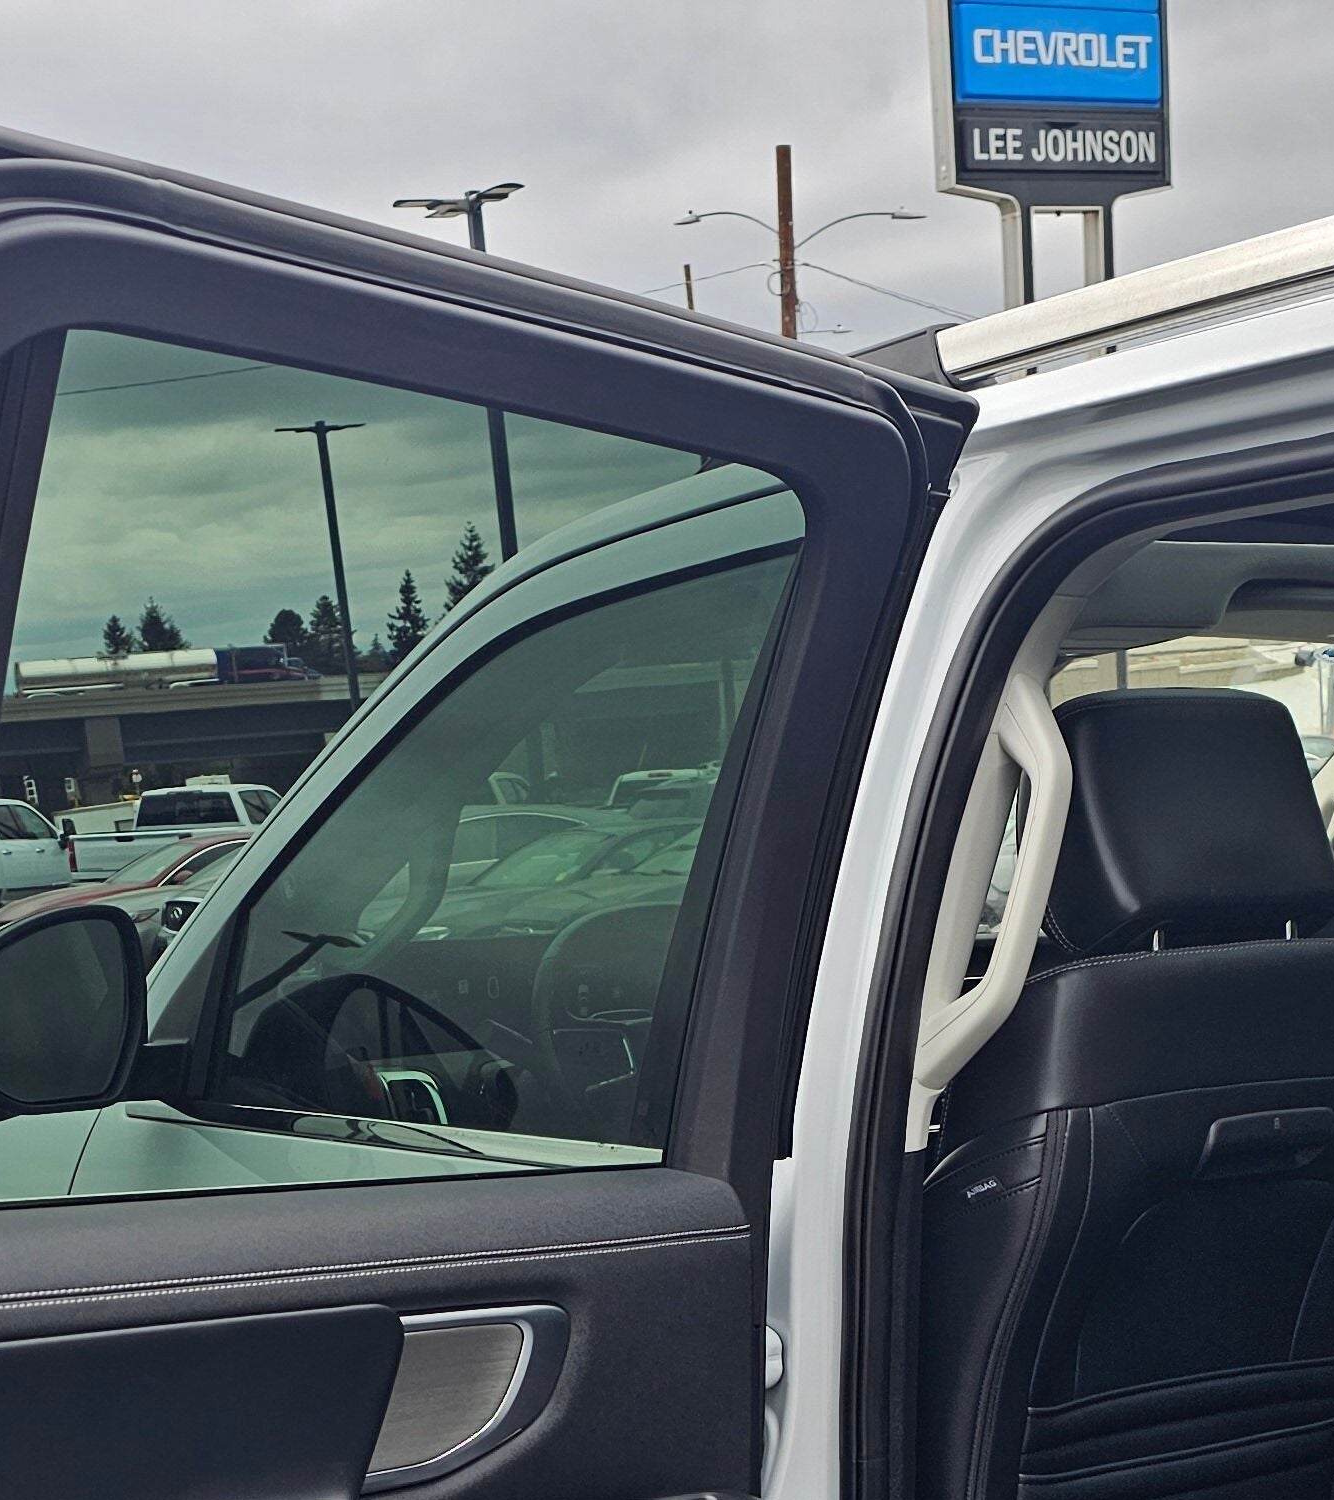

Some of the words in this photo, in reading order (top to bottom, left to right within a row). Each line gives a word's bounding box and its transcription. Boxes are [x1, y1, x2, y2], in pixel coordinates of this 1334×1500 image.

[973, 28, 1153, 69] CHEVROLET
[973, 127, 1024, 161] LEE
[1031, 129, 1156, 163] JOHNSON
[966, 1179, 997, 1199] AIRBAG
